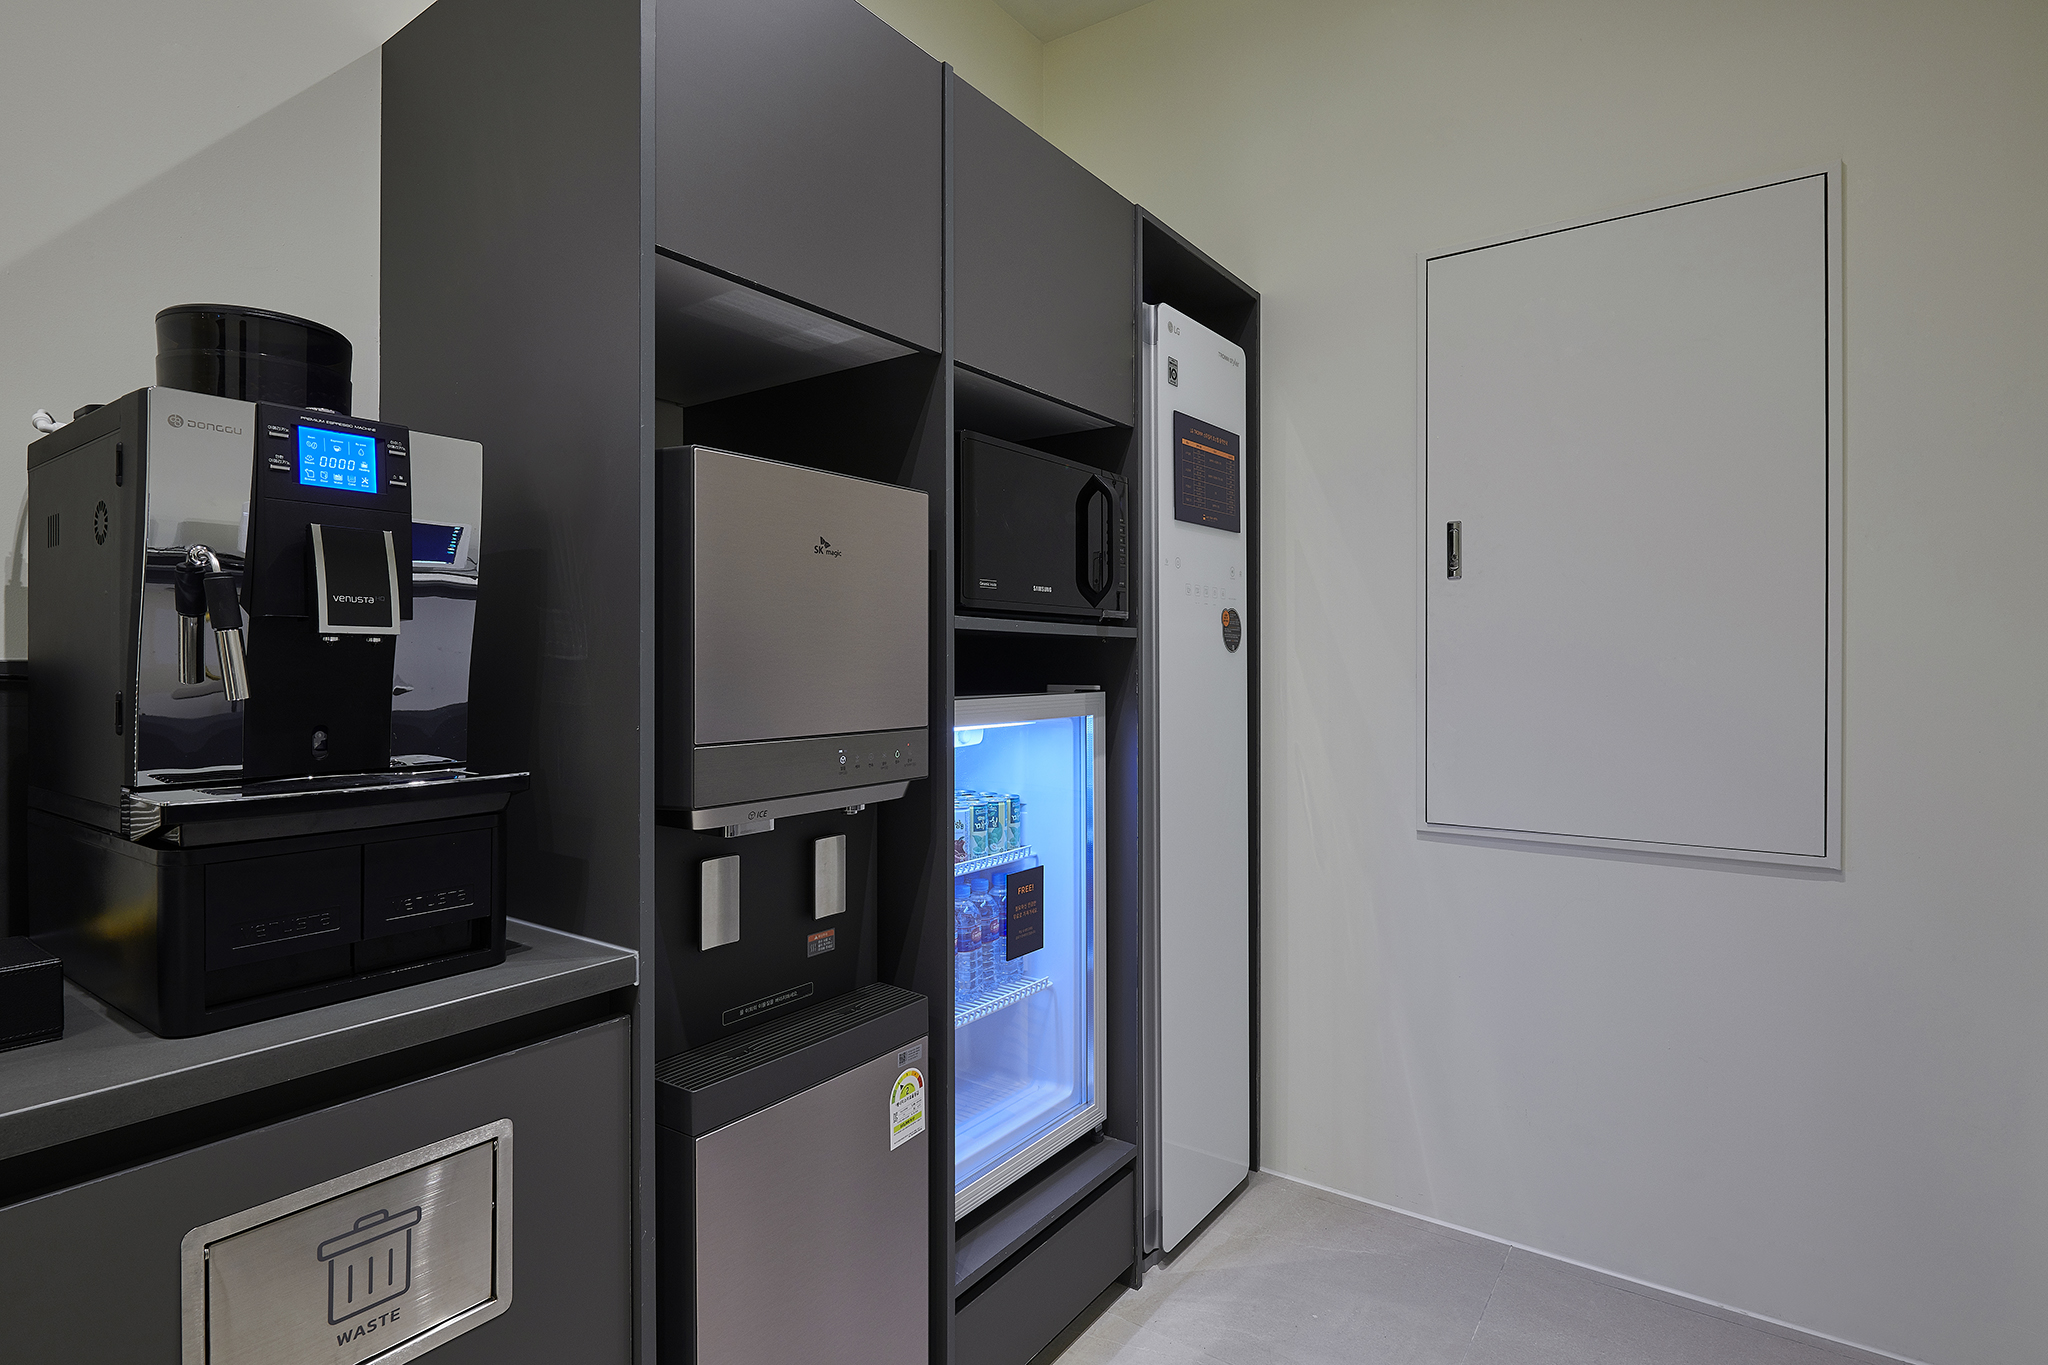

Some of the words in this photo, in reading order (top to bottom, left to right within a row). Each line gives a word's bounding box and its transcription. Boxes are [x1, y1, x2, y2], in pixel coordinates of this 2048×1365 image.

[187, 419, 242, 435] DONGGU
[300, 416, 325, 424] PREMIUM
[326, 420, 353, 429] ESPRESSO
[354, 425, 377, 433] MACHINE
[319, 455, 356, 471] 0000
[813, 545, 824, 555] SK
[825, 549, 842, 558] magic
[1033, 585, 1053, 593] SAMSUNG
[756, 810, 768, 818] ICE
[1017, 883, 1035, 895] FREE!
[336, 1307, 401, 1347] WASTE
